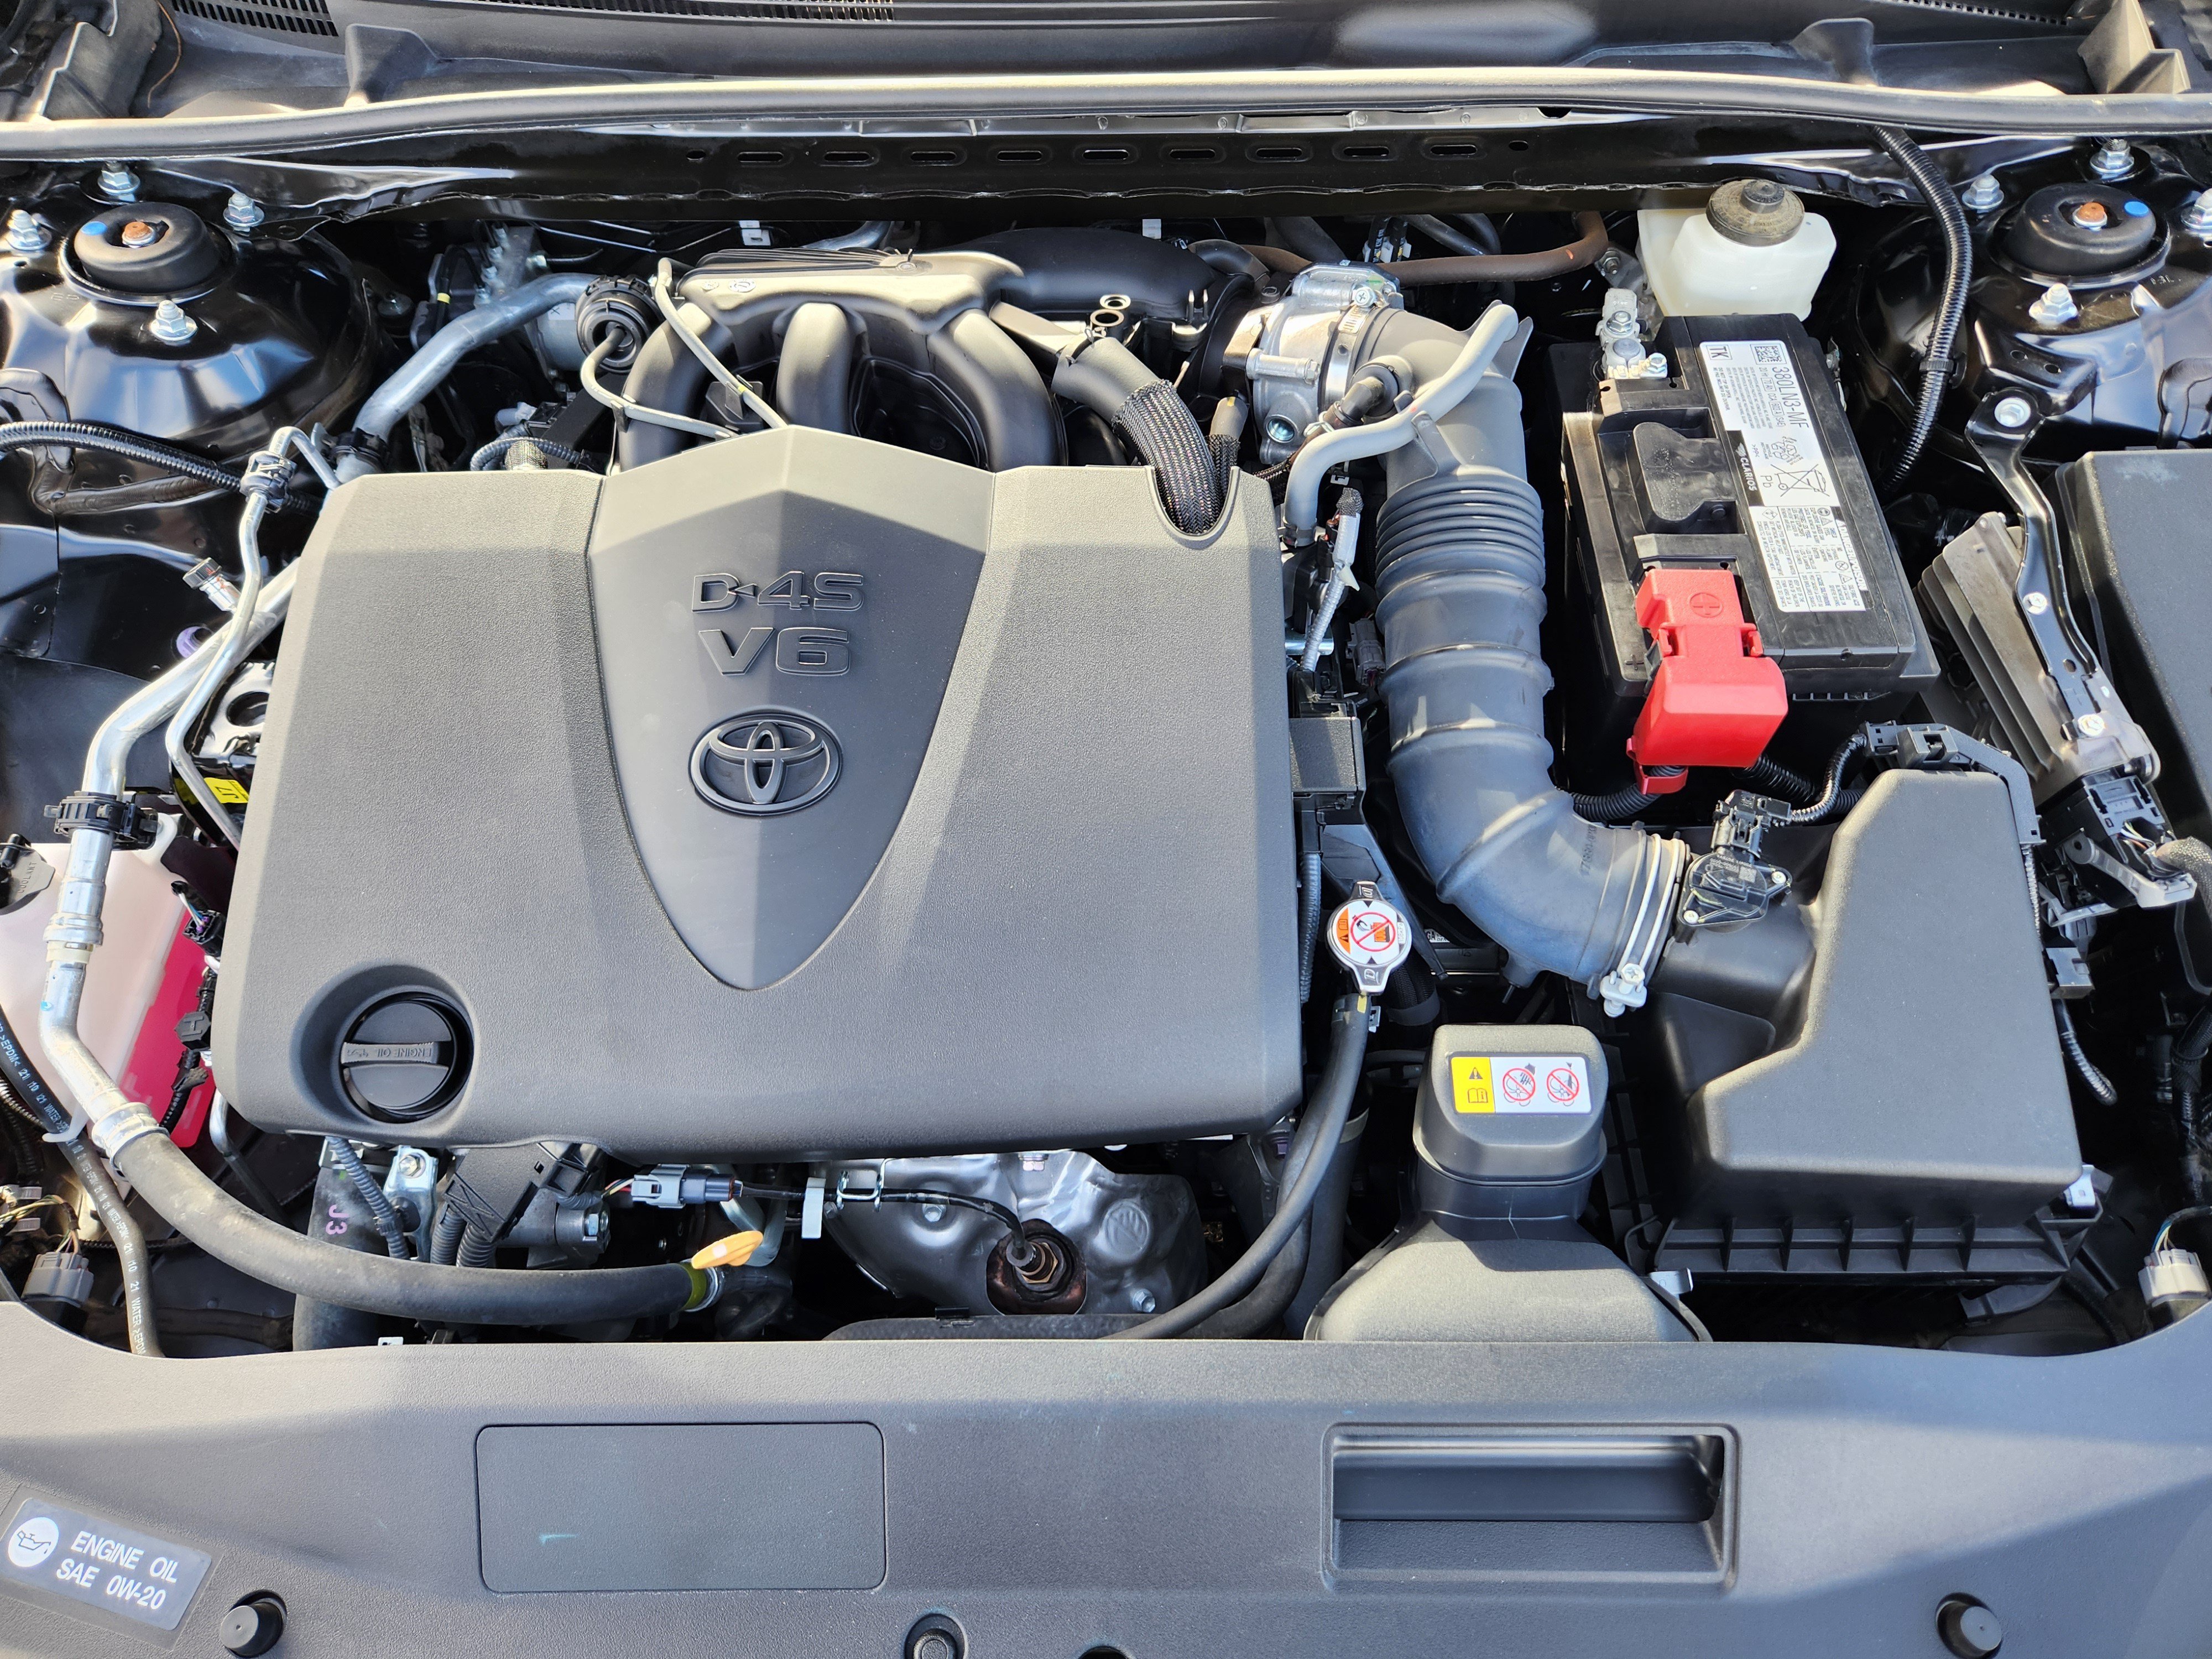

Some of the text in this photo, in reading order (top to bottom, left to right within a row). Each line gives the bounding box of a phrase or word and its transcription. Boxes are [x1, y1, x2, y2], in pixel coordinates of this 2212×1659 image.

[1708, 346, 1729, 358] TK
[1771, 367, 1809, 428] 380LN3-MF
[1772, 416, 1786, 427] (SAE)
[1739, 457, 1758, 491] CLARIOS
[1759, 474, 1775, 488] Pb
[698, 627, 852, 676] V6
[17, 860, 37, 895] COOLANT
[1426, 931, 1436, 940] GA
[376, 1047, 432, 1058] ENGINE OIL
[44, 1103, 61, 1123] WATER
[326, 1204, 348, 1235] J3
[131, 1296, 142, 1328] WATER
[70, 1530, 178, 1583] ENGINE OIL
[56, 1558, 166, 1610] SAE 0W-20
